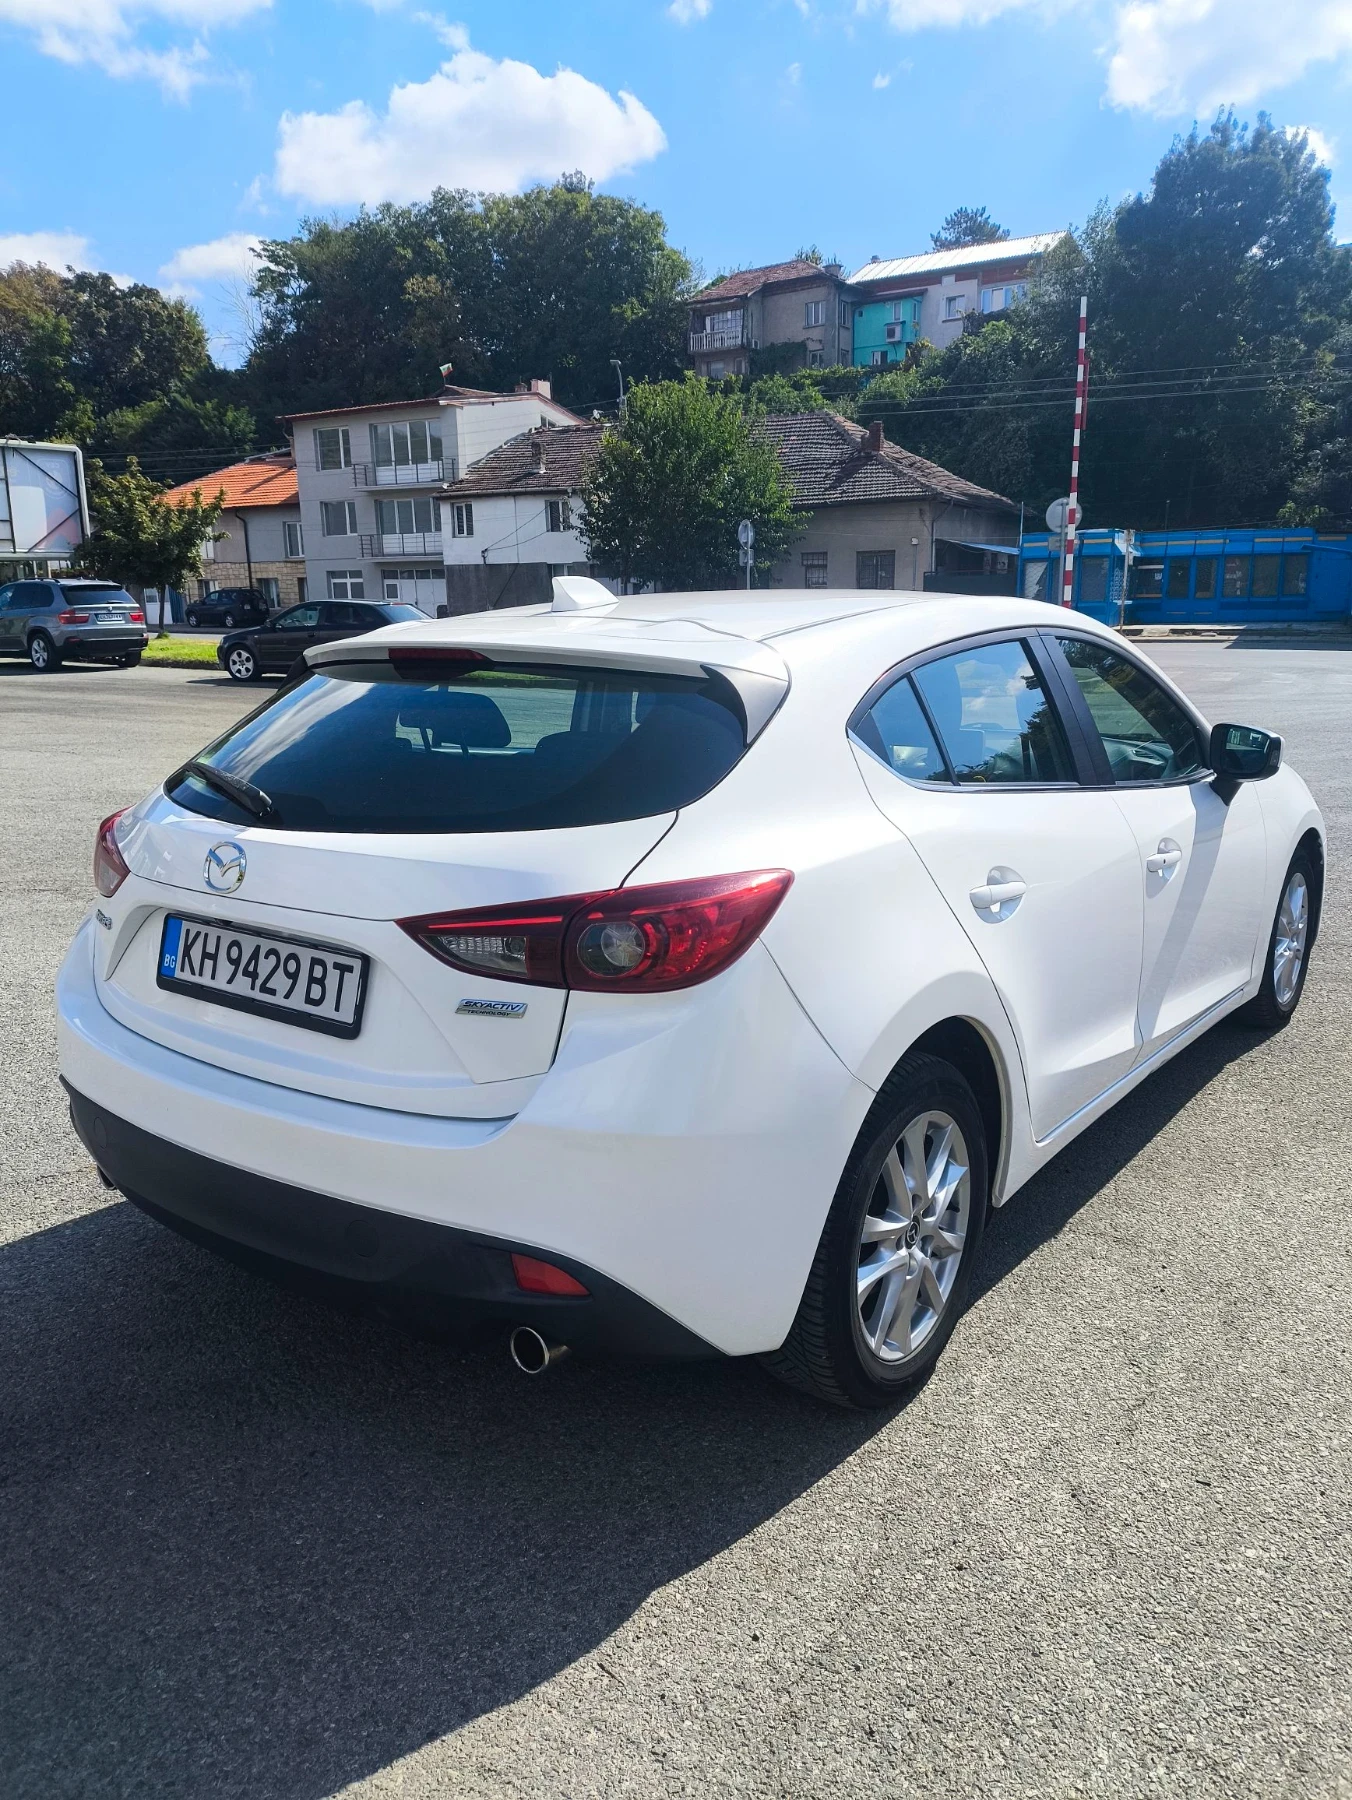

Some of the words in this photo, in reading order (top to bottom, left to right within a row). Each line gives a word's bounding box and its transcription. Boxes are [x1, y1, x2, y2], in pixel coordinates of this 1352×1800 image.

[164, 954, 176, 968] BG
[463, 1000, 520, 1011] SKYACTIV
[467, 1009, 511, 1017] TECHNOLOGY
